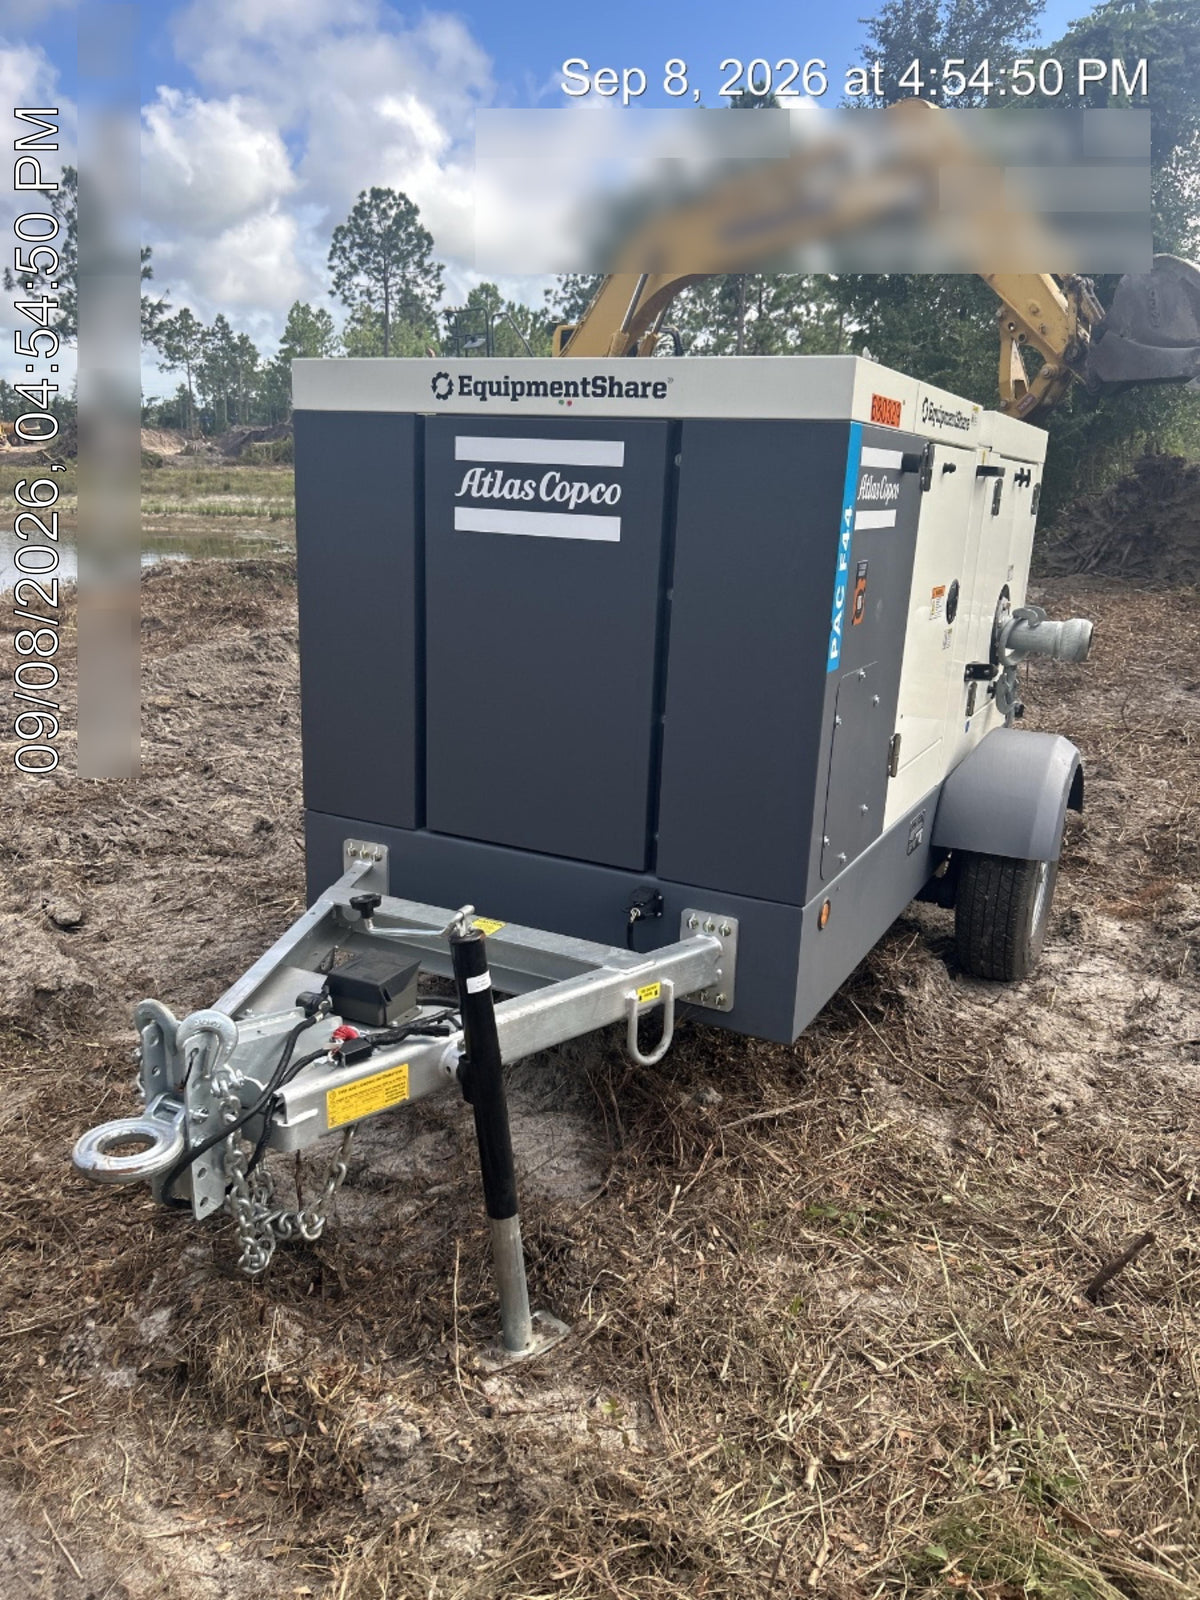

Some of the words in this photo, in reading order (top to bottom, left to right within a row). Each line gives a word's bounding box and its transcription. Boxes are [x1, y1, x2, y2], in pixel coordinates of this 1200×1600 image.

[458, 375, 669, 402] EquipmentShare
[455, 467, 536, 501] Atlas
[539, 471, 622, 510] Copco
[857, 473, 880, 500] Atlas
[829, 585, 845, 660] PAC
[838, 504, 853, 571] F44
